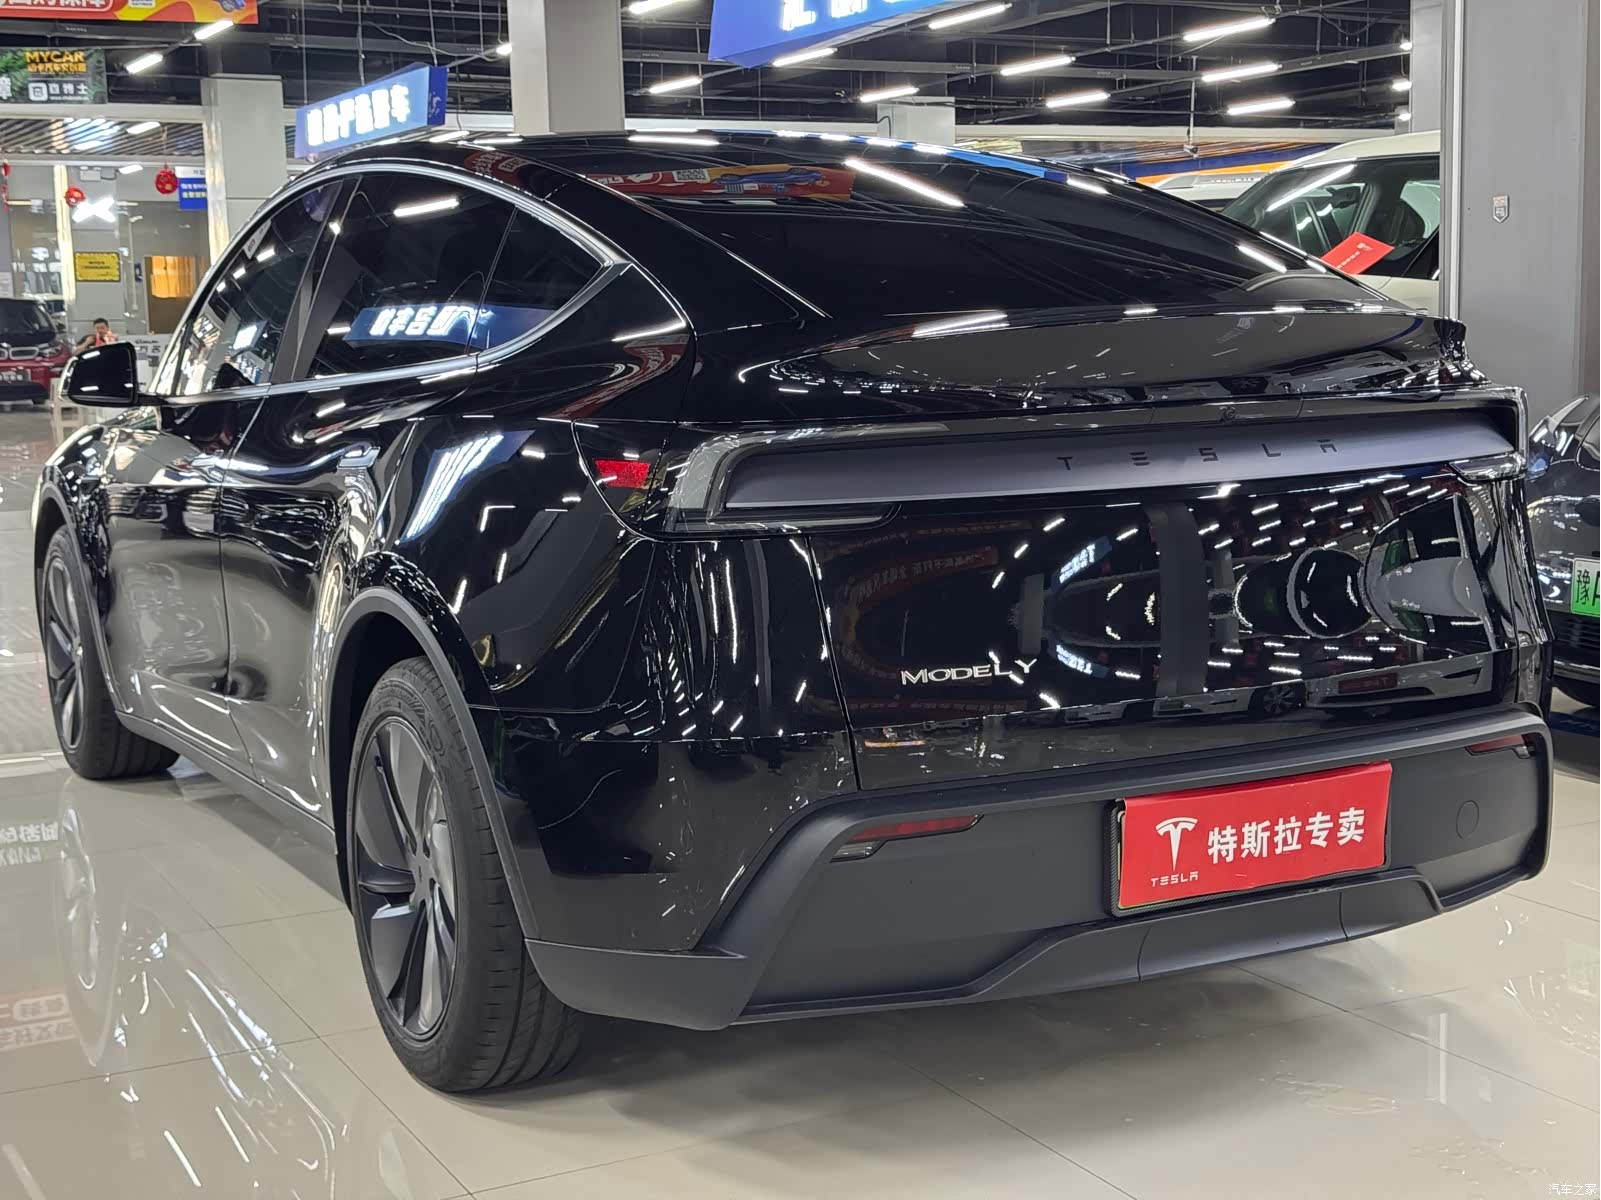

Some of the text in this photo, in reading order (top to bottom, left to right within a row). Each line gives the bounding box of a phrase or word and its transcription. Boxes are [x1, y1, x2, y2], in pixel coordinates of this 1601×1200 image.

[25, 50, 85, 63] MYCAR
[1056, 439, 1338, 471] TESLA
[1207, 806, 1365, 864] 特斯拉专卖
[1150, 871, 1199, 887] TESLA
